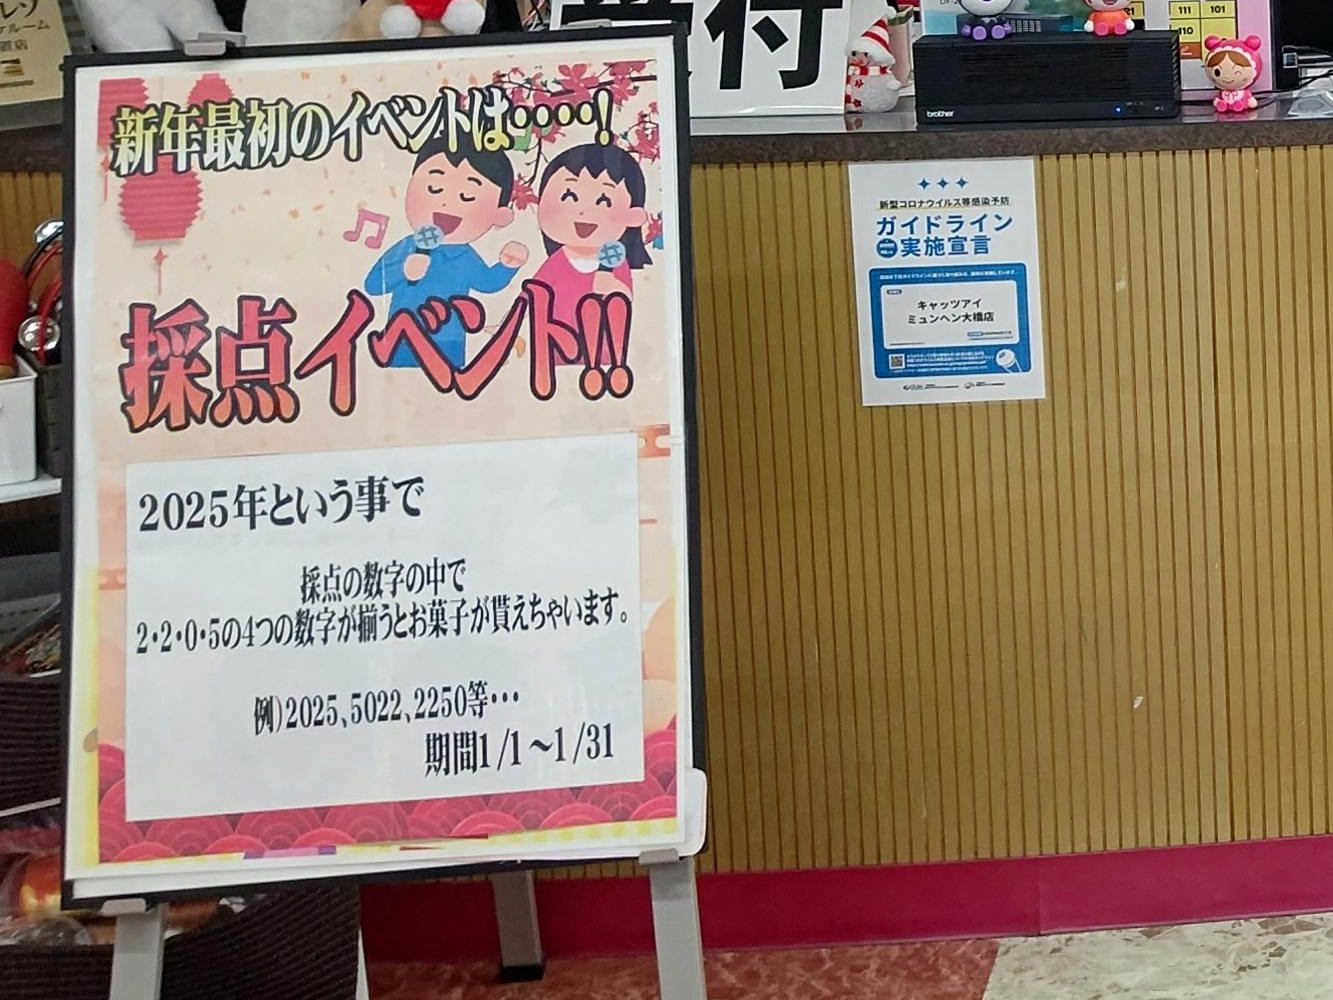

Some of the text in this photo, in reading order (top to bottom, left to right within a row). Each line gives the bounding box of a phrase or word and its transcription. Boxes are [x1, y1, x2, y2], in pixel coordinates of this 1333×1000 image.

[1210, 4, 1225, 13] 101
[926, 109, 955, 118] brother
[876, 214, 1013, 236] ガイドライン
[900, 235, 992, 257] 実施宣言
[917, 299, 981, 310] キャッツアイ
[907, 312, 994, 324] ミュンヘン大橋店
[118, 279, 634, 433] 採点イベント!!
[139, 475, 425, 534] 2025年という事で
[300, 557, 467, 605] 採点の数字の中で
